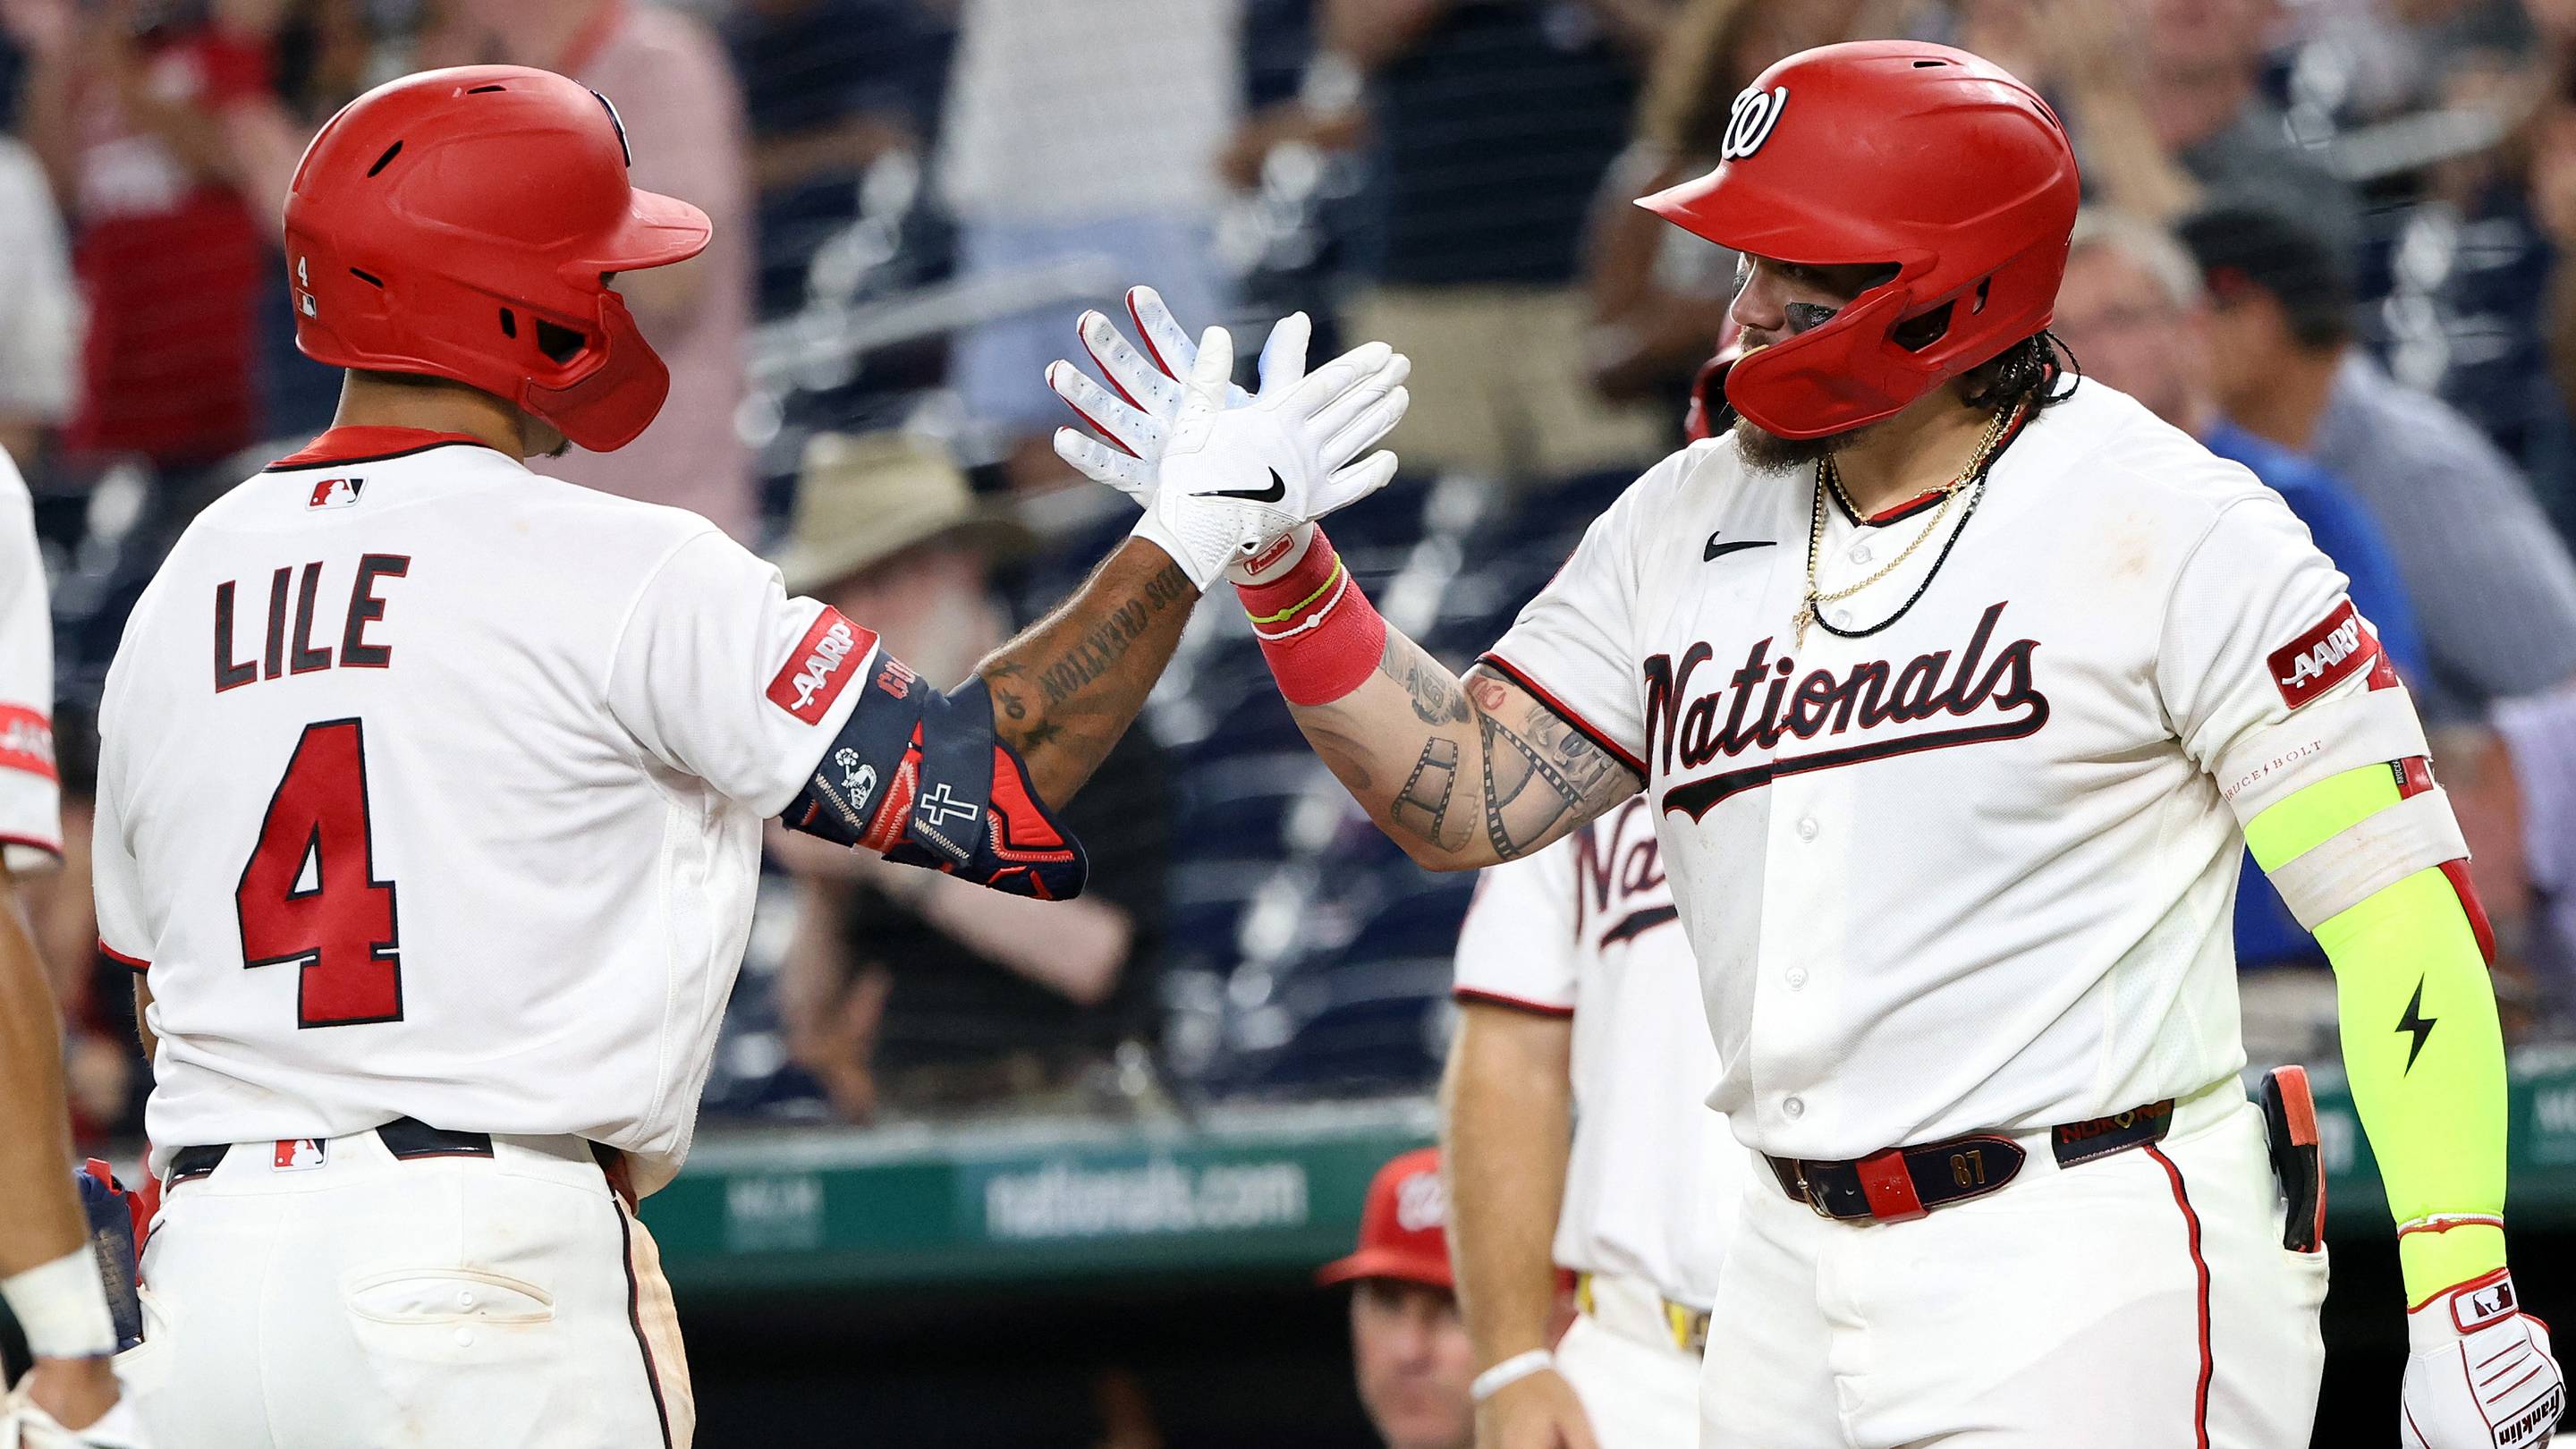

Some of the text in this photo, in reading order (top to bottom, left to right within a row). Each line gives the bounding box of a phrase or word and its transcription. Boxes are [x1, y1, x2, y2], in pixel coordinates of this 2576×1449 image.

[1721, 86, 1789, 159] W
[297, 256, 309, 287] 4
[215, 553, 411, 693] LILE
[790, 618, 854, 711] AARP
[2281, 614, 2360, 689] AARP
[877, 657, 920, 699] GO
[1644, 600, 2050, 796] Nationals
[234, 717, 404, 1029] 4
